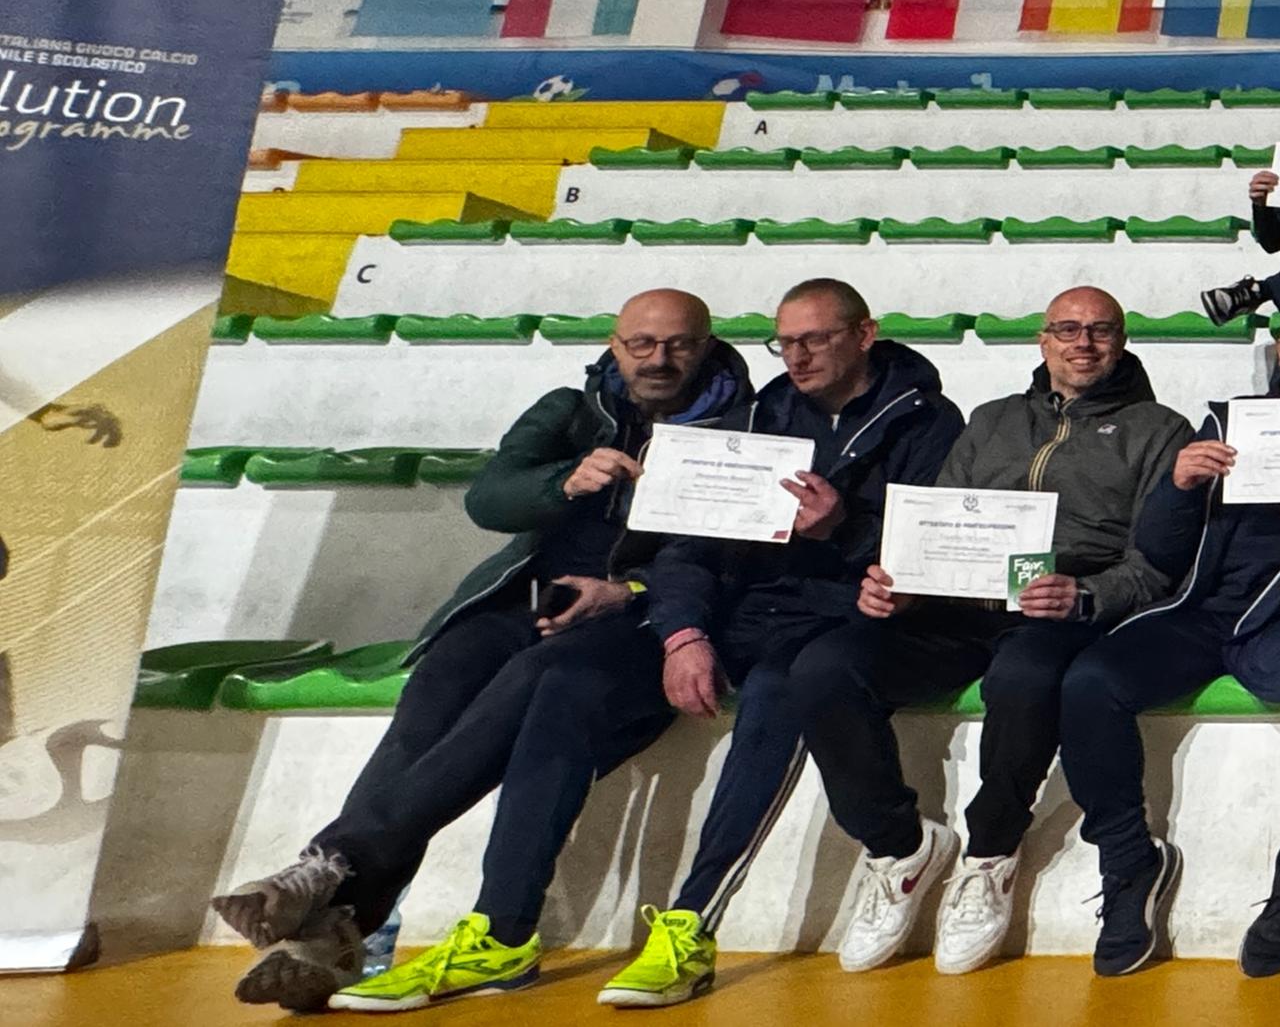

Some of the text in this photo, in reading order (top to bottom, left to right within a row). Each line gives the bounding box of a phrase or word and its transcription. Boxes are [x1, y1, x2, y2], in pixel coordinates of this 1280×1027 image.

[38, 52, 49, 64] E
[753, 120, 770, 135] A
[565, 186, 580, 204] B
[356, 263, 377, 284] C
